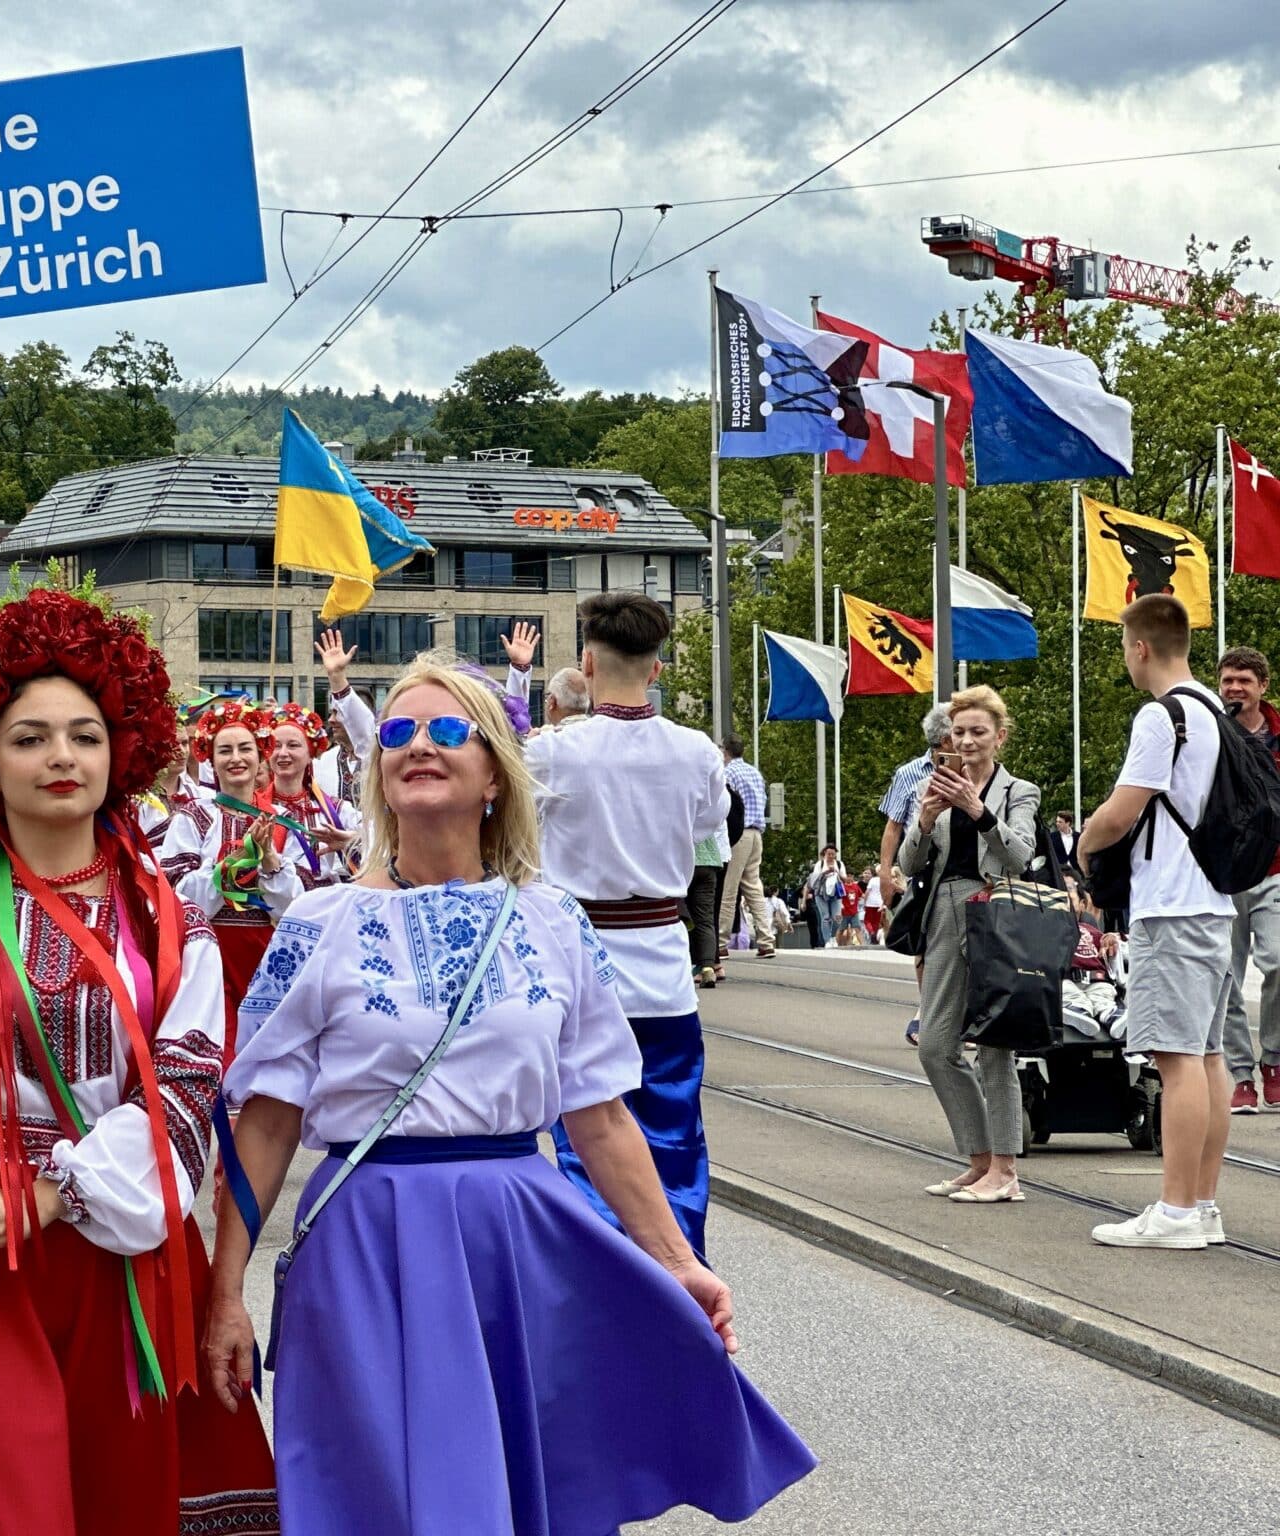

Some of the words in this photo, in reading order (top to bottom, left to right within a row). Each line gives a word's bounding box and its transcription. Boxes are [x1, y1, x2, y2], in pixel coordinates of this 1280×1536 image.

[729, 322, 741, 428] EIDGENÖSSISCHES
[740, 341, 751, 428] TRACHTENFEST
[513, 508, 573, 532] coop
[576, 506, 619, 534] city
